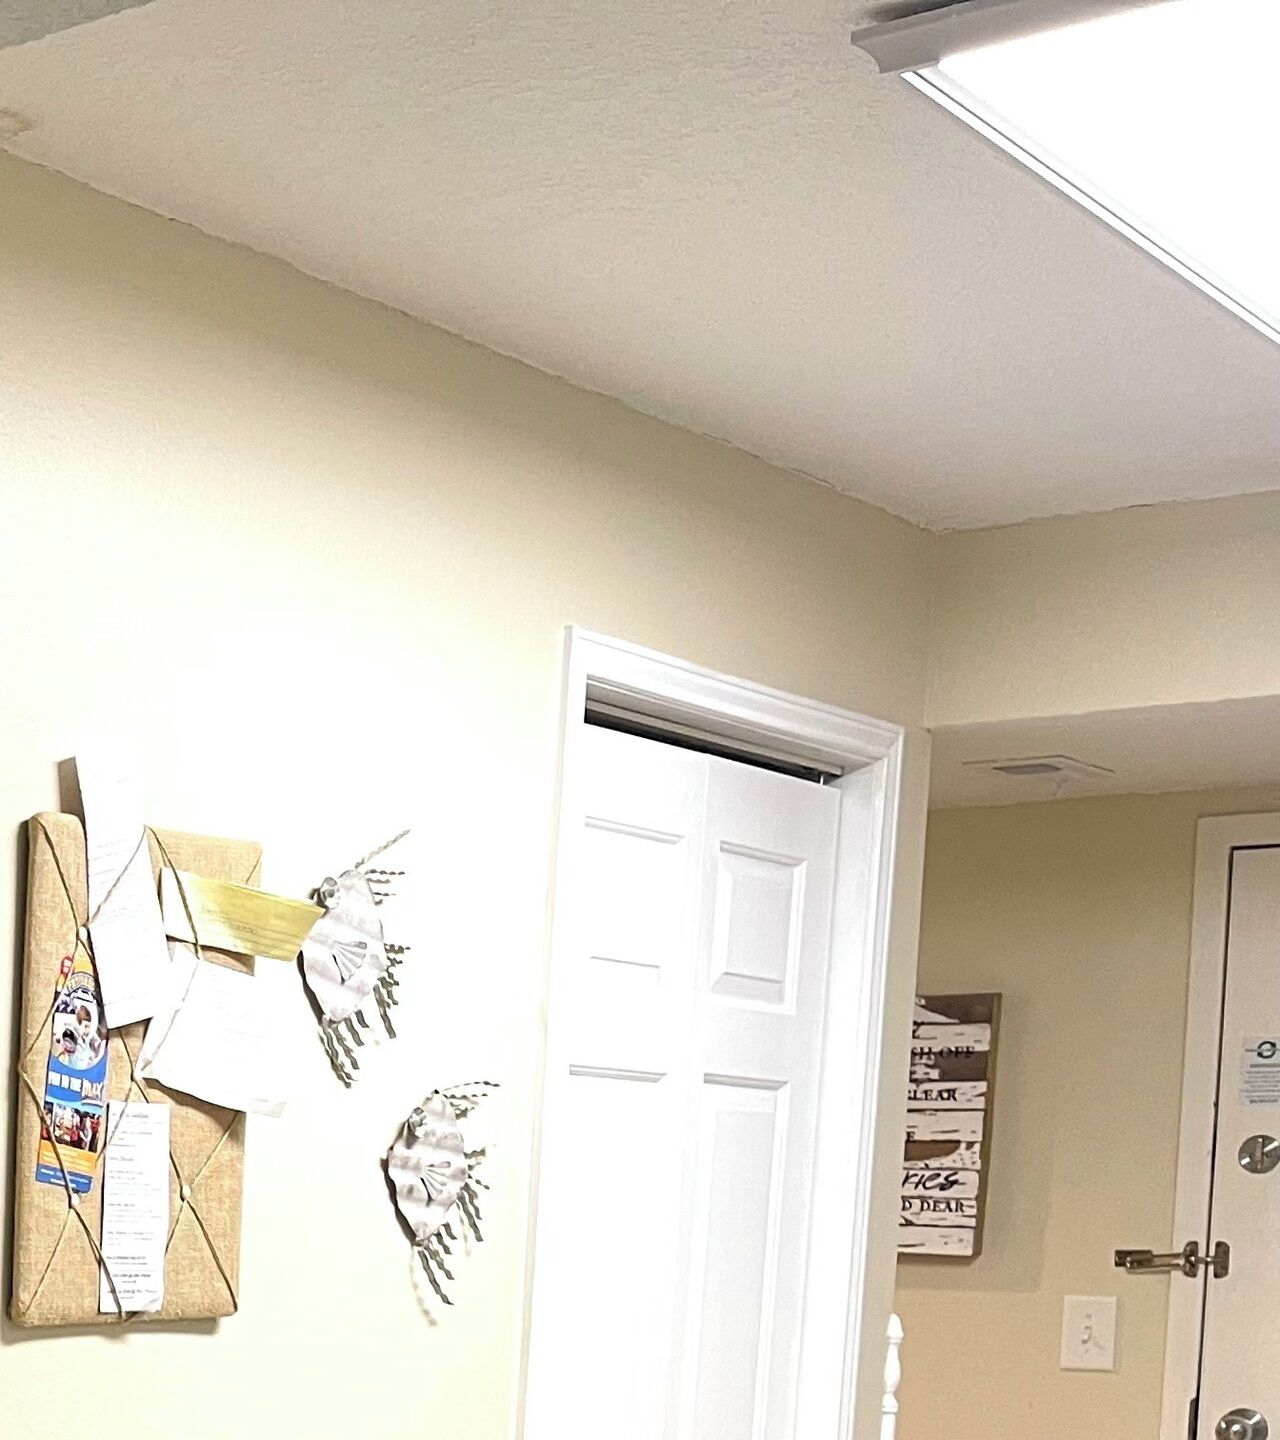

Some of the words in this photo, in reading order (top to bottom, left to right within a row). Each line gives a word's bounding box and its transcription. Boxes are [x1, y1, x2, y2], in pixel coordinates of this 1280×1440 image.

[939, 1046, 975, 1059] OFF
[81, 1078, 105, 1100] MAX
[920, 1199, 966, 1214] DEAR
